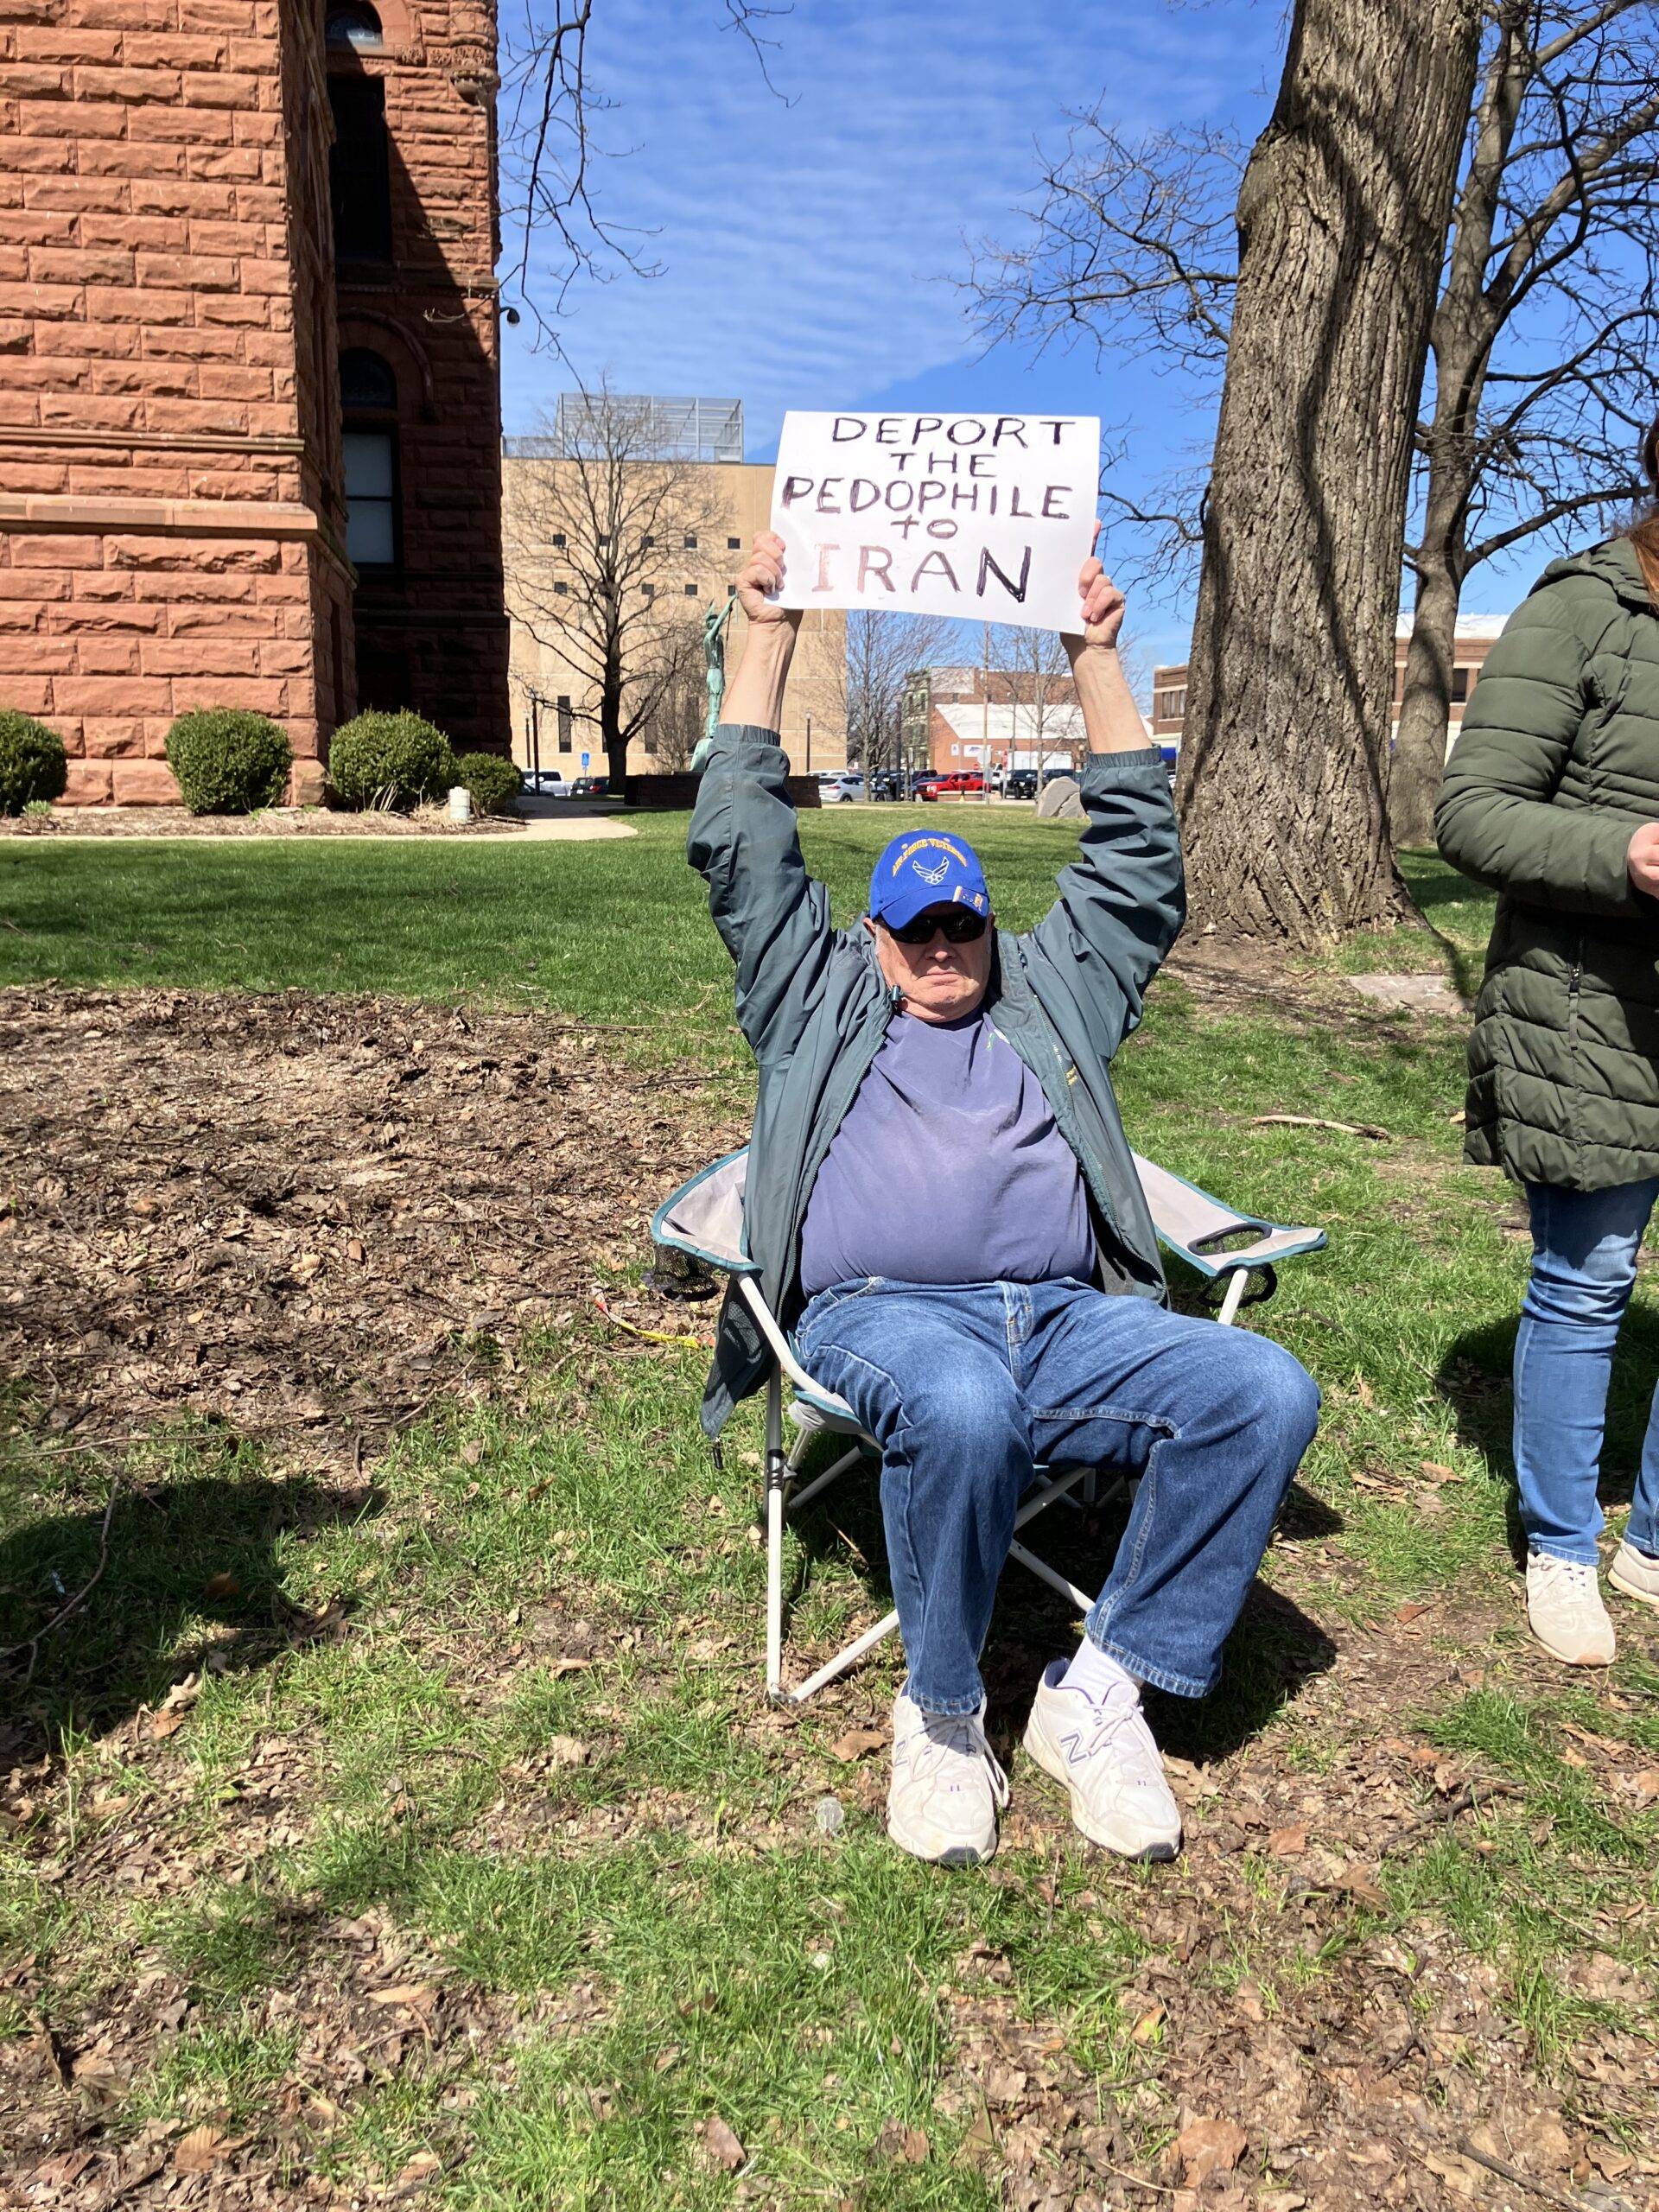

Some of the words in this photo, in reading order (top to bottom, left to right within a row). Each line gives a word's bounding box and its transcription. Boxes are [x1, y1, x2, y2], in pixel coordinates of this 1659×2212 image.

[832, 417, 1076, 448] DEPORT
[888, 451, 997, 478] THE
[782, 476, 1072, 519] PEDOPHILE
[811, 543, 1032, 603] IRAN
